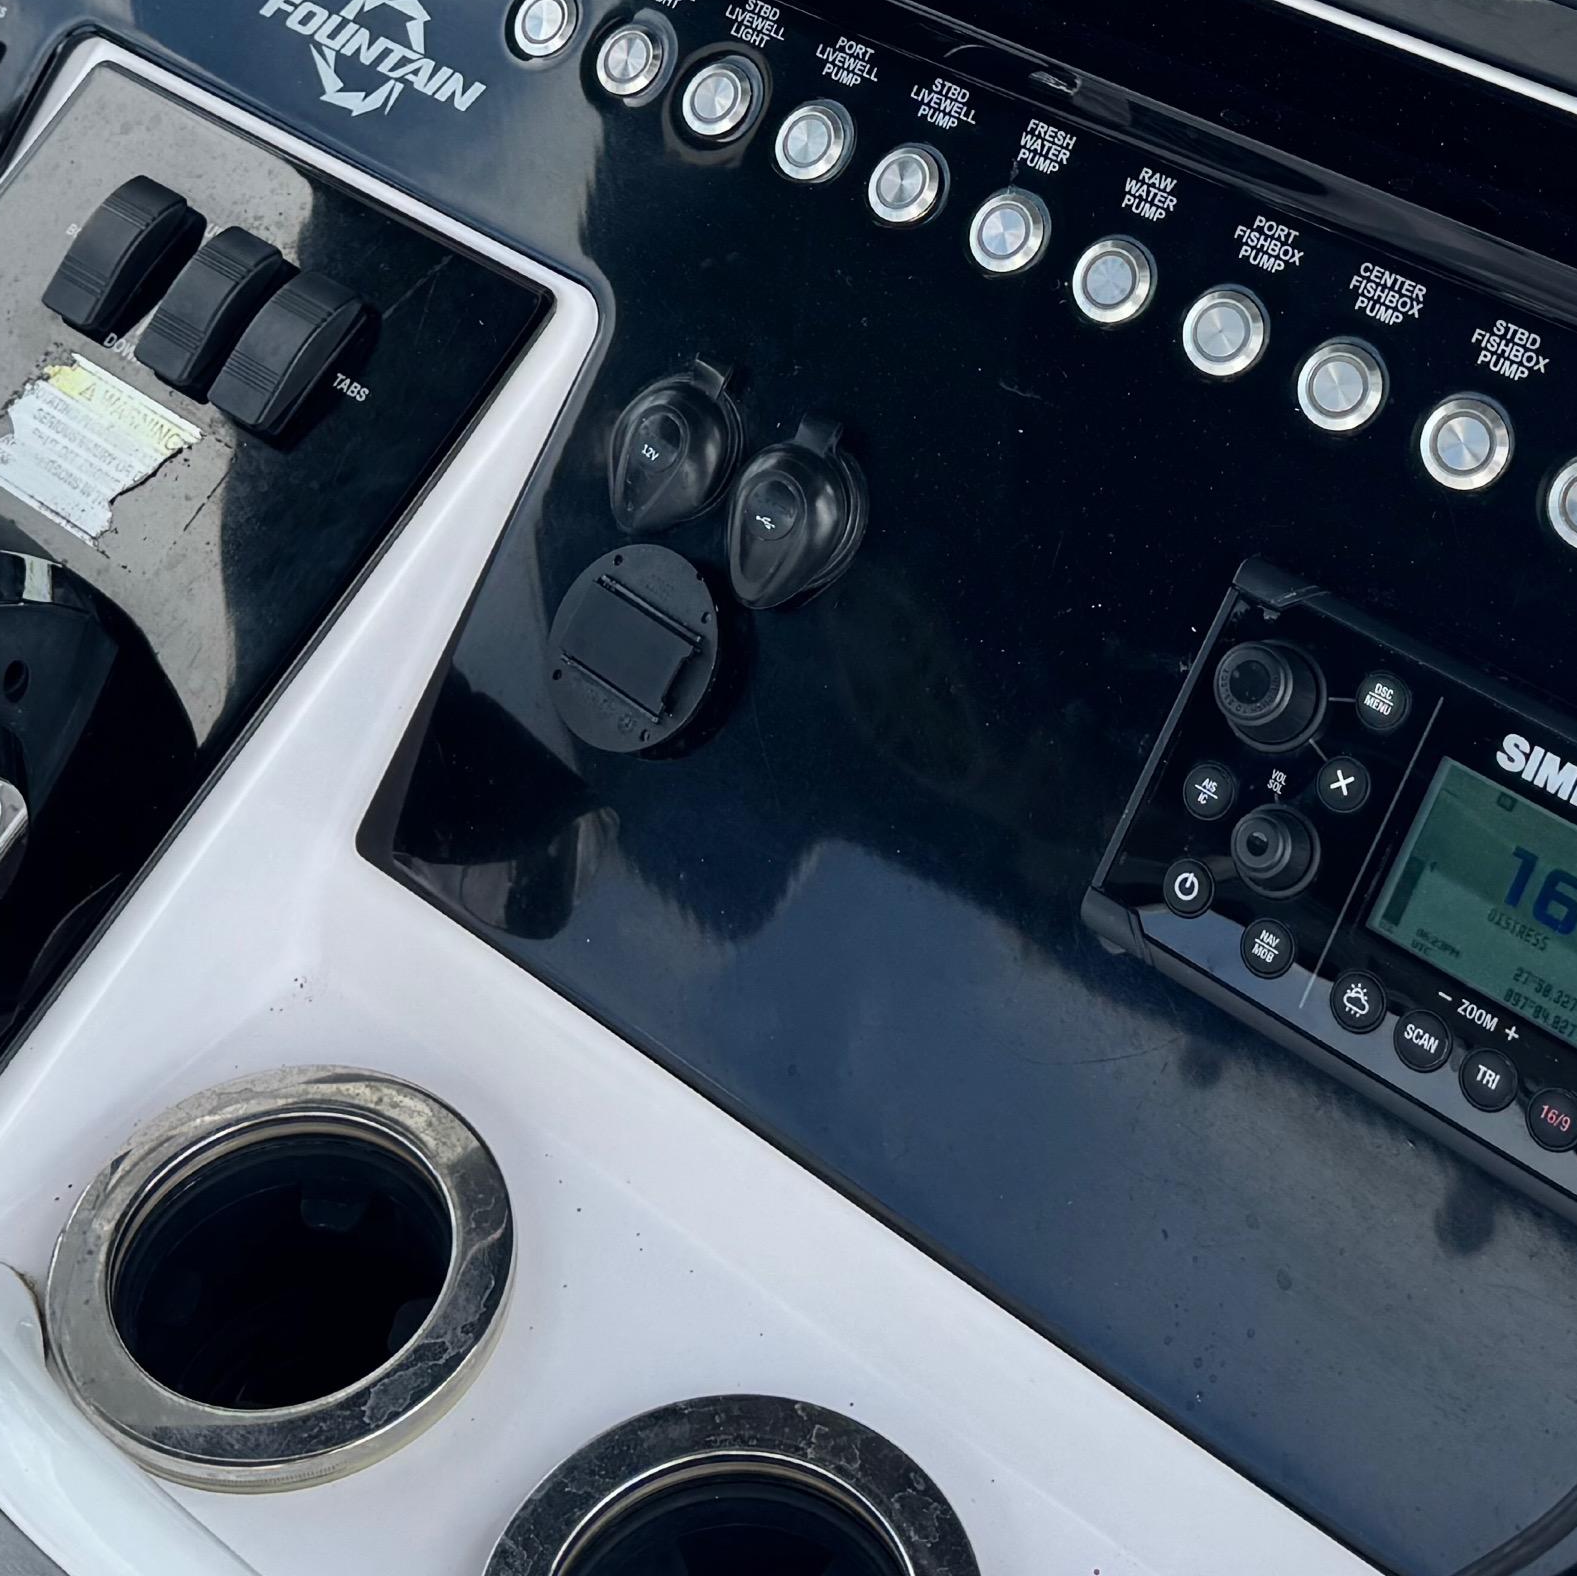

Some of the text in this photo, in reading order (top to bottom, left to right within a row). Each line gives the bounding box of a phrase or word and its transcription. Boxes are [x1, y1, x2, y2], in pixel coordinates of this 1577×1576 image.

[725, 4, 785, 41] LIVEWELL
[731, 22, 771, 49] LIGHT
[816, 44, 878, 82] LIVEWELL
[836, 36, 875, 60] PORT
[823, 62, 862, 89] PUMP
[931, 78, 970, 103] STBD
[910, 84, 976, 125] LIVEWELL
[917, 104, 958, 132] PUMP
[1019, 131, 1070, 166] WATER
[1026, 119, 1077, 150] FRESH
[1017, 148, 1059, 176] PUMP
[1124, 177, 1178, 212] WATER
[1138, 167, 1178, 193] RAW
[1122, 194, 1167, 222] PUMP
[1233, 224, 1304, 266] FISHBOX
[1254, 215, 1299, 245] PORT
[1238, 245, 1285, 275] PUMP
[1349, 275, 1424, 318] FISHBOX
[1359, 262, 1427, 302] CENTER
[1354, 296, 1403, 326] PUMP
[1493, 319, 1541, 350] STBD
[1471, 328, 1550, 374] FISHBOX
[1477, 349, 1529, 382] PUMP
[331, 372, 370, 404] TABS
[641, 442, 660, 461] 12V
[1364, 694, 1393, 716] MENU
[1375, 683, 1394, 700] DSC
[1201, 777, 1217, 793] AIS
[1272, 768, 1287, 785] VOL
[1197, 793, 1208, 804] IC
[1259, 929, 1279, 947] NAV
[1487, 907, 1550, 952] DISTRESS
[1252, 944, 1274, 963] MOB
[1457, 998, 1499, 1031] ZOOM
[1403, 1024, 1439, 1054] SCAN
[1476, 1064, 1500, 1090] TRI
[1540, 1104, 1572, 1132] 16/9
